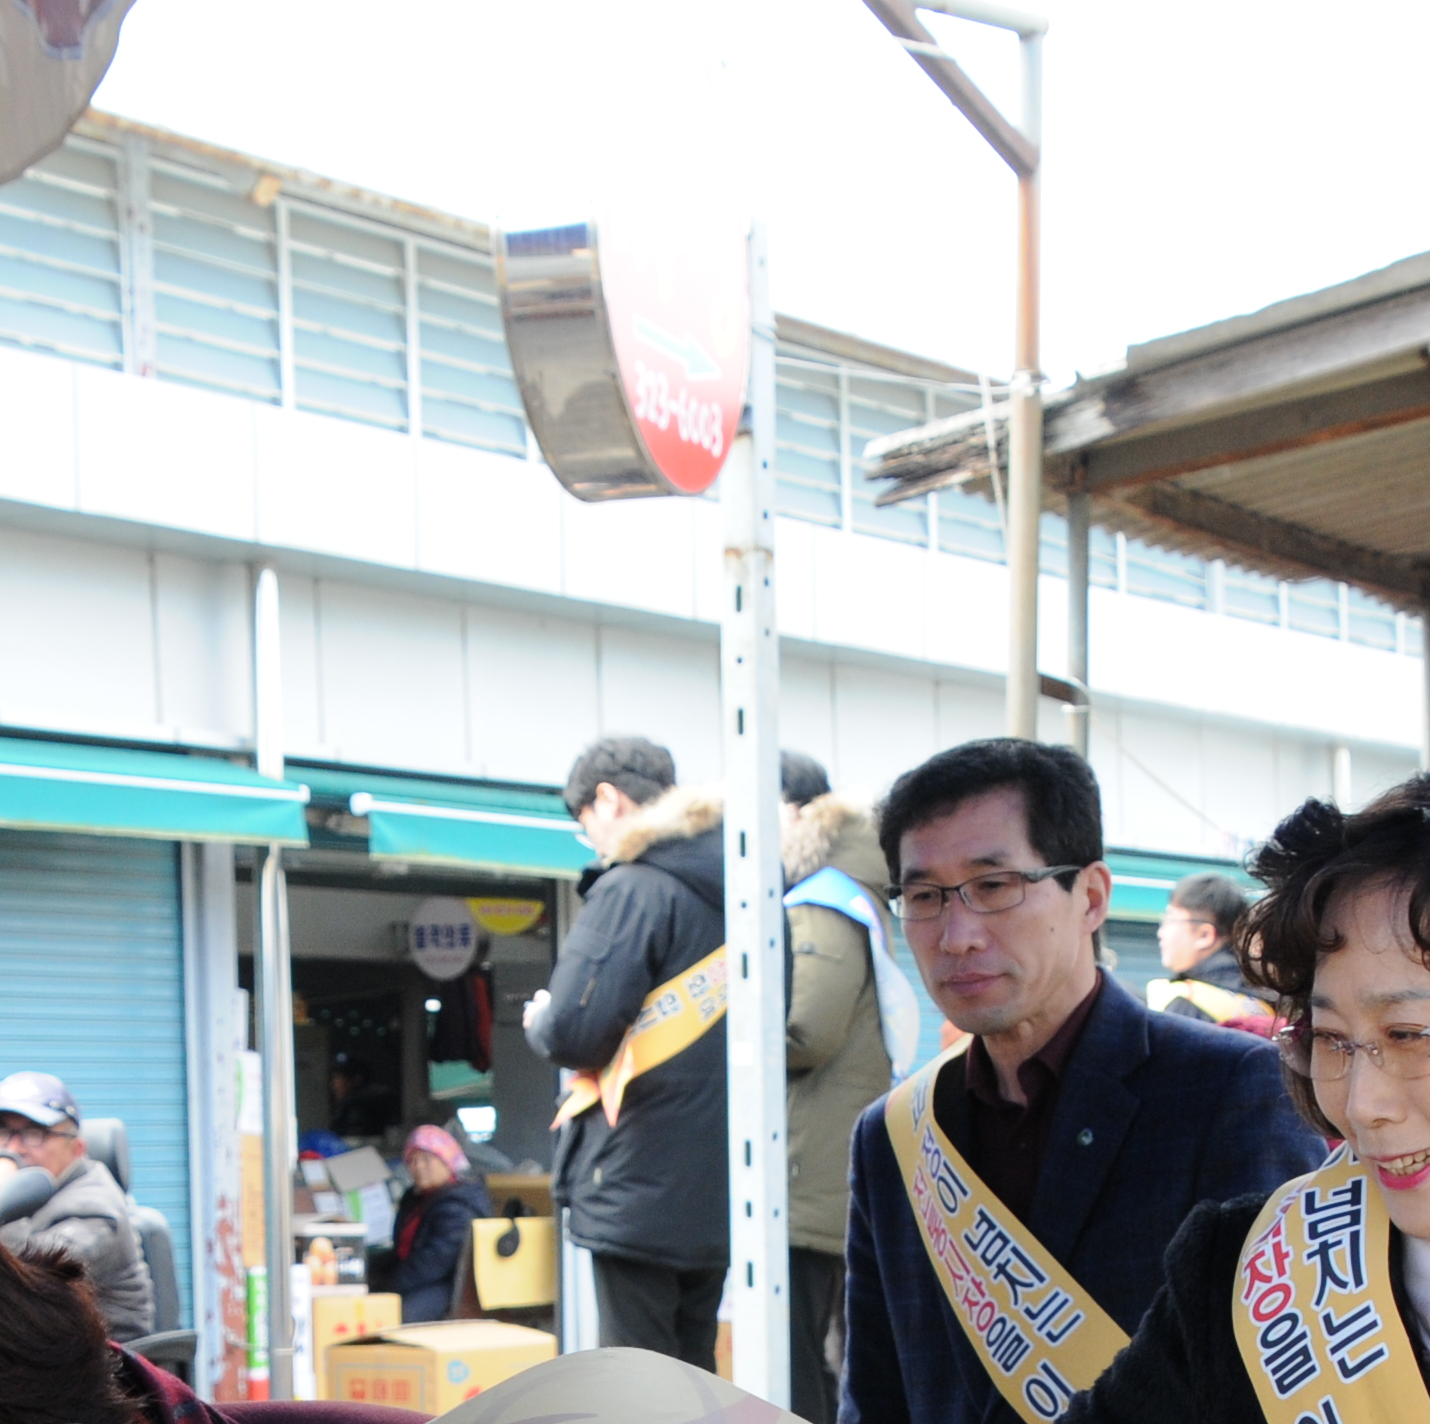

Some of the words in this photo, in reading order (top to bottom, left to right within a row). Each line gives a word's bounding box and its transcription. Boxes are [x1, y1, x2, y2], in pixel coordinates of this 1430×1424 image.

[913, 1167, 1031, 1374] 전통시장을
[963, 1208, 1085, 1344] 넘치는
[1303, 1178, 1387, 1380] 넘치는
